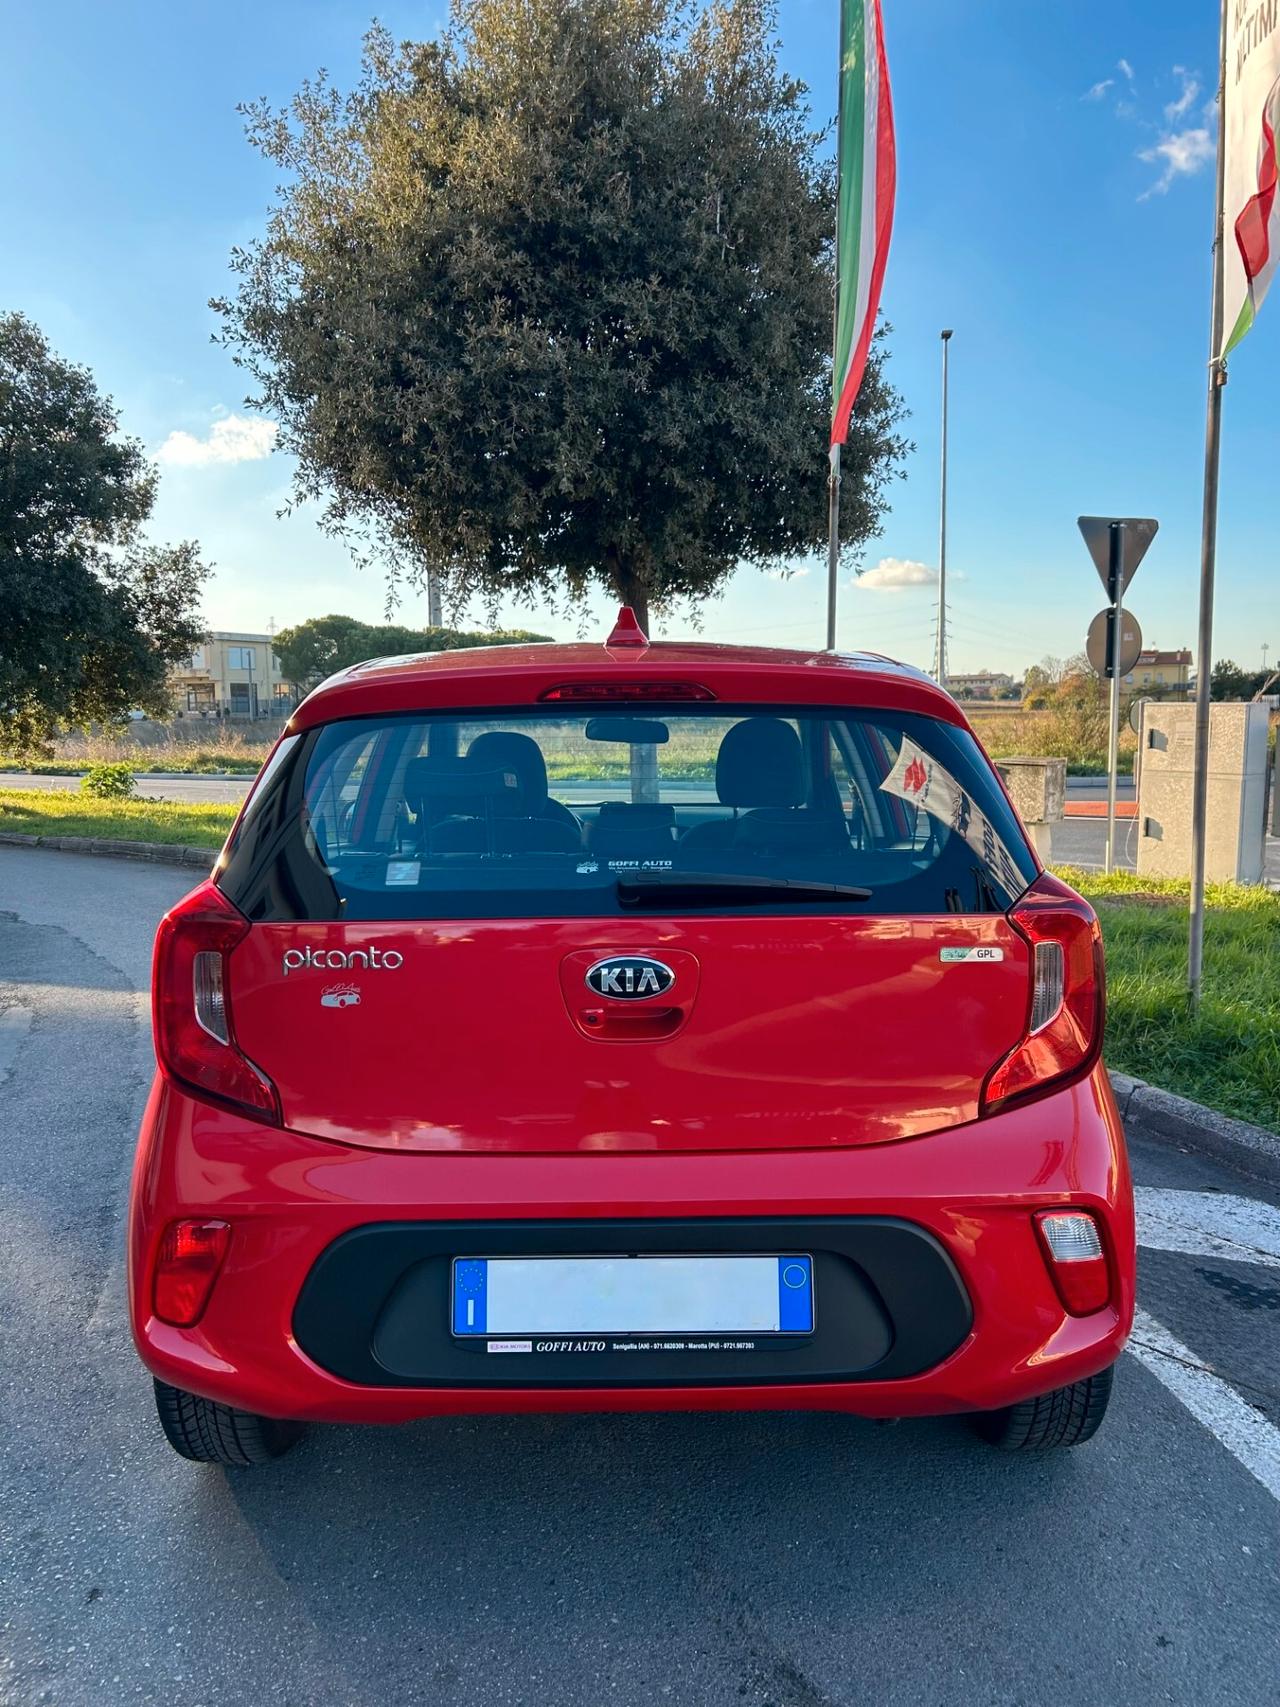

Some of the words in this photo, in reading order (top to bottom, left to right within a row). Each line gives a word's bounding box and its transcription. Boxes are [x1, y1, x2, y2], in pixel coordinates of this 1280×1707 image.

[283, 945, 404, 976] picanto
[976, 949, 995, 958] GPL
[600, 967, 661, 992] KIA
[536, 1341, 573, 1352] GOFFI
[573, 1341, 606, 1352] AUTO
